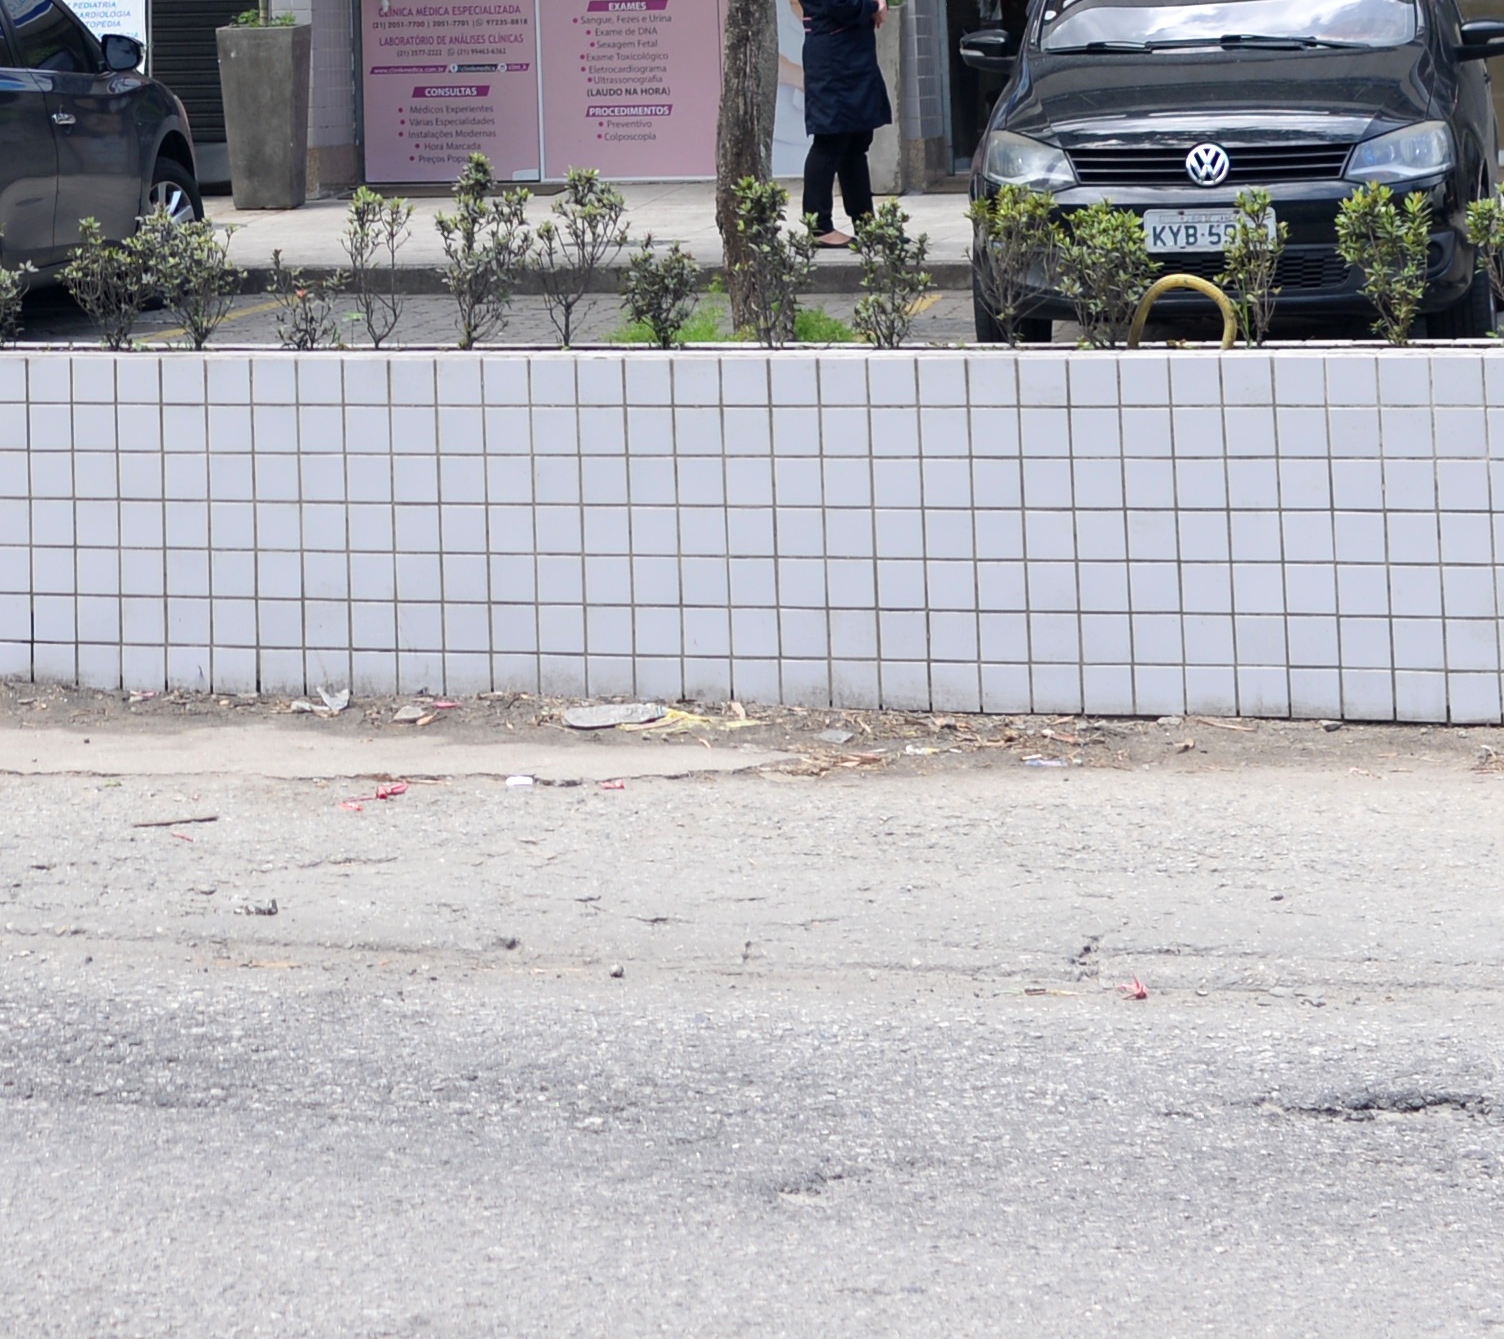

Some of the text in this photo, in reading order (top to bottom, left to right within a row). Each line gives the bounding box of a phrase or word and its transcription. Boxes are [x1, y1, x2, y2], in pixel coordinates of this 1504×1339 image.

[416, 4, 521, 17] MÉDICA ESPECIALIZADA
[608, 1, 647, 11] EXAMES
[77, 10, 131, 19] ARDIOLOGIA
[617, 15, 640, 23] Fezes
[649, 14, 672, 23] Urina
[595, 27, 658, 36] Exame de DNA
[379, 32, 523, 47] LABORATÓRIO DE ANÁLISES CLÍNICAS
[596, 39, 658, 50] Sexagem Fetal
[586, 52, 669, 62] Exame Toxicológico
[589, 65, 667, 75] Eletrocardiograma
[593, 75, 663, 85] Ultrassonografia
[425, 87, 477, 97] CONSULTAS
[587, 86, 671, 97] (LAUDO NA HORA)
[410, 104, 494, 115] Médicos Experientes
[589, 105, 669, 116] PROCEDIMENTOS
[409, 116, 495, 127] Várias Especialidades
[607, 120, 652, 129] Preventivo
[408, 129, 497, 140] Instalações Modernas
[604, 132, 657, 142] Colposcopia
[424, 141, 481, 151] Hora Marcada
[418, 154, 445, 164] Preços
